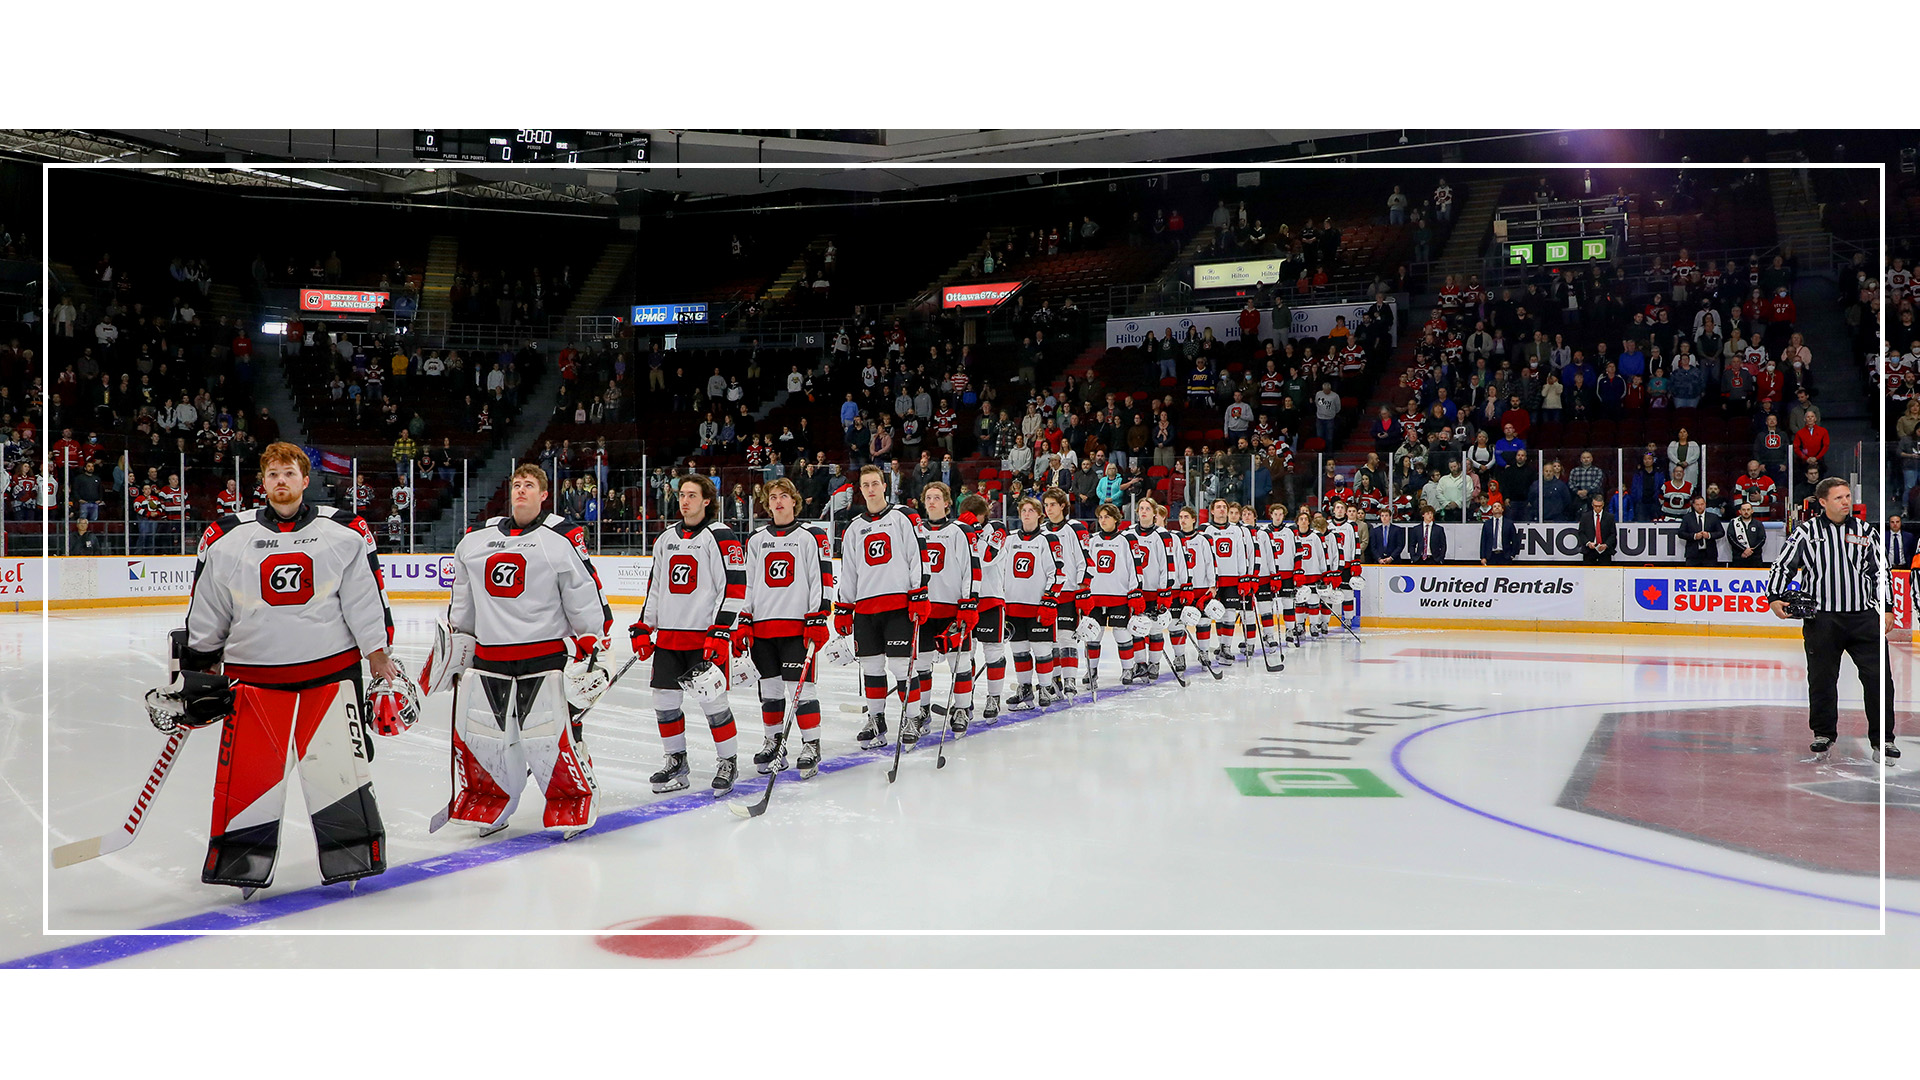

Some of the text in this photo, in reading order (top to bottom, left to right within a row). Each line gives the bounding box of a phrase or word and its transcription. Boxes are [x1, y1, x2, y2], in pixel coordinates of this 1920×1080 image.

[426, 135, 434, 146] 0
[516, 128, 552, 144] 20:00
[502, 146, 512, 160] 0
[638, 150, 645, 160] 0
[1147, 178, 1158, 187] 17
[1548, 246, 1567, 258] TD
[1584, 243, 1604, 256] TD
[634, 312, 666, 323] KPMG
[610, 342, 619, 350] 16
[805, 336, 815, 344] 16
[1420, 577, 1574, 594] United Rentals
[1674, 579, 1722, 592] REAL
[1420, 598, 1449, 608] Work
[1674, 594, 1771, 613] SUPERS
[1894, 576, 1904, 628] CCM
[345, 702, 365, 760] CCM
[1243, 700, 1487, 761] PLACE
[561, 751, 587, 793] CCM
[1258, 770, 1360, 794] TD
